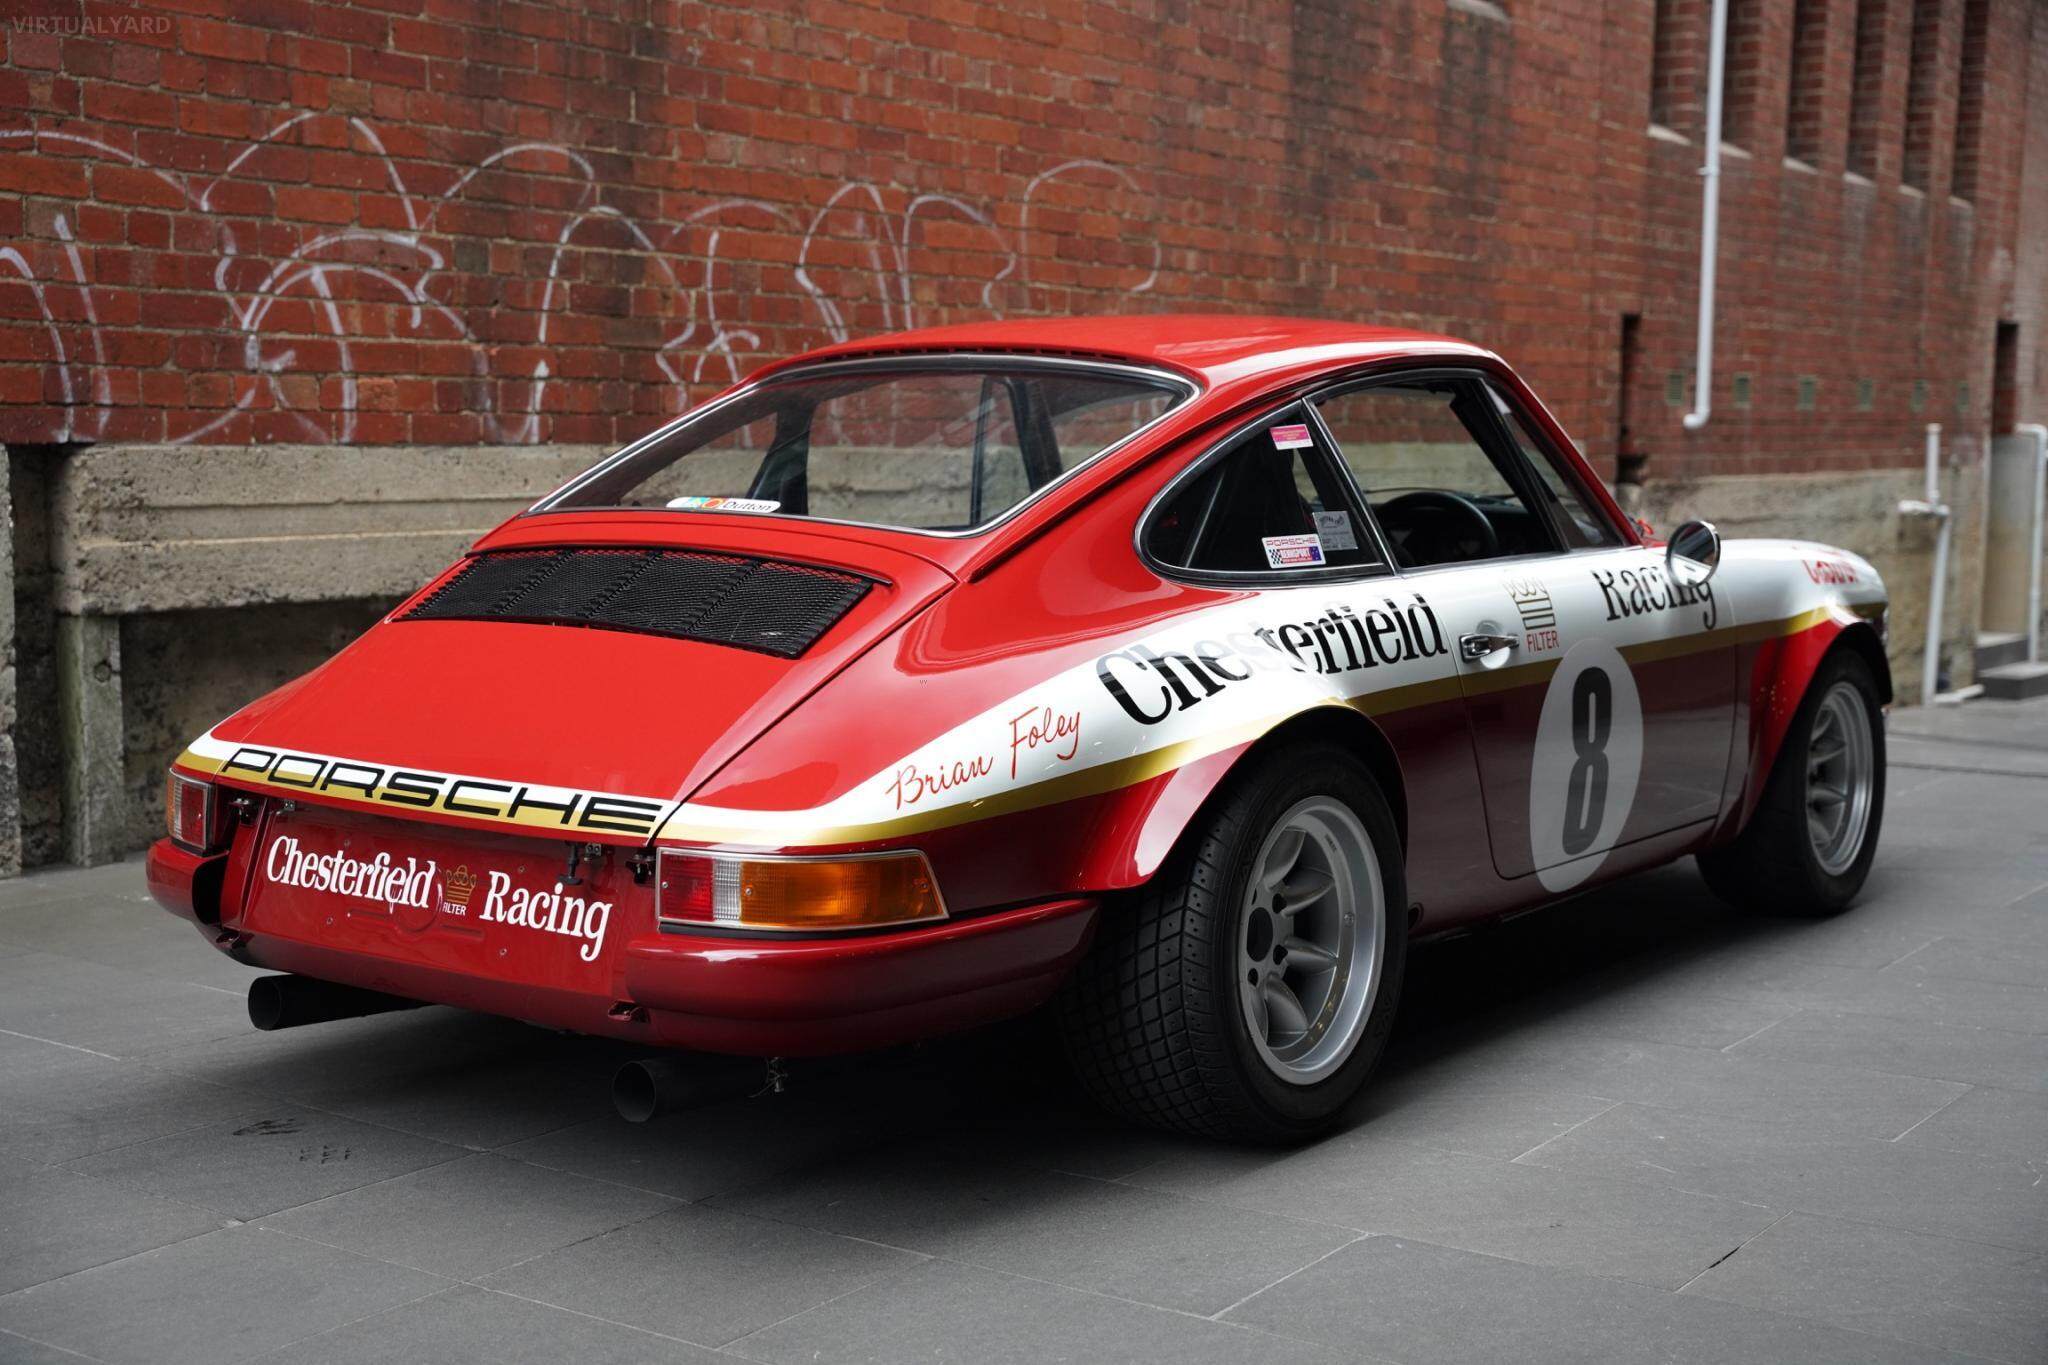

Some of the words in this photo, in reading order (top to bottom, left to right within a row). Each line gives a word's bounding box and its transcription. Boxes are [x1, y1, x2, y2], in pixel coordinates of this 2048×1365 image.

[1095, 592, 1449, 726] Chesterfield
[1526, 630, 1560, 653] FILTER
[221, 747, 664, 835] PORSCHE
[884, 755, 994, 811] Brian
[1008, 705, 1081, 780] Foley
[1562, 666, 1612, 856] 8
[266, 835, 437, 909] Chesterfield
[479, 870, 613, 962] Racing
